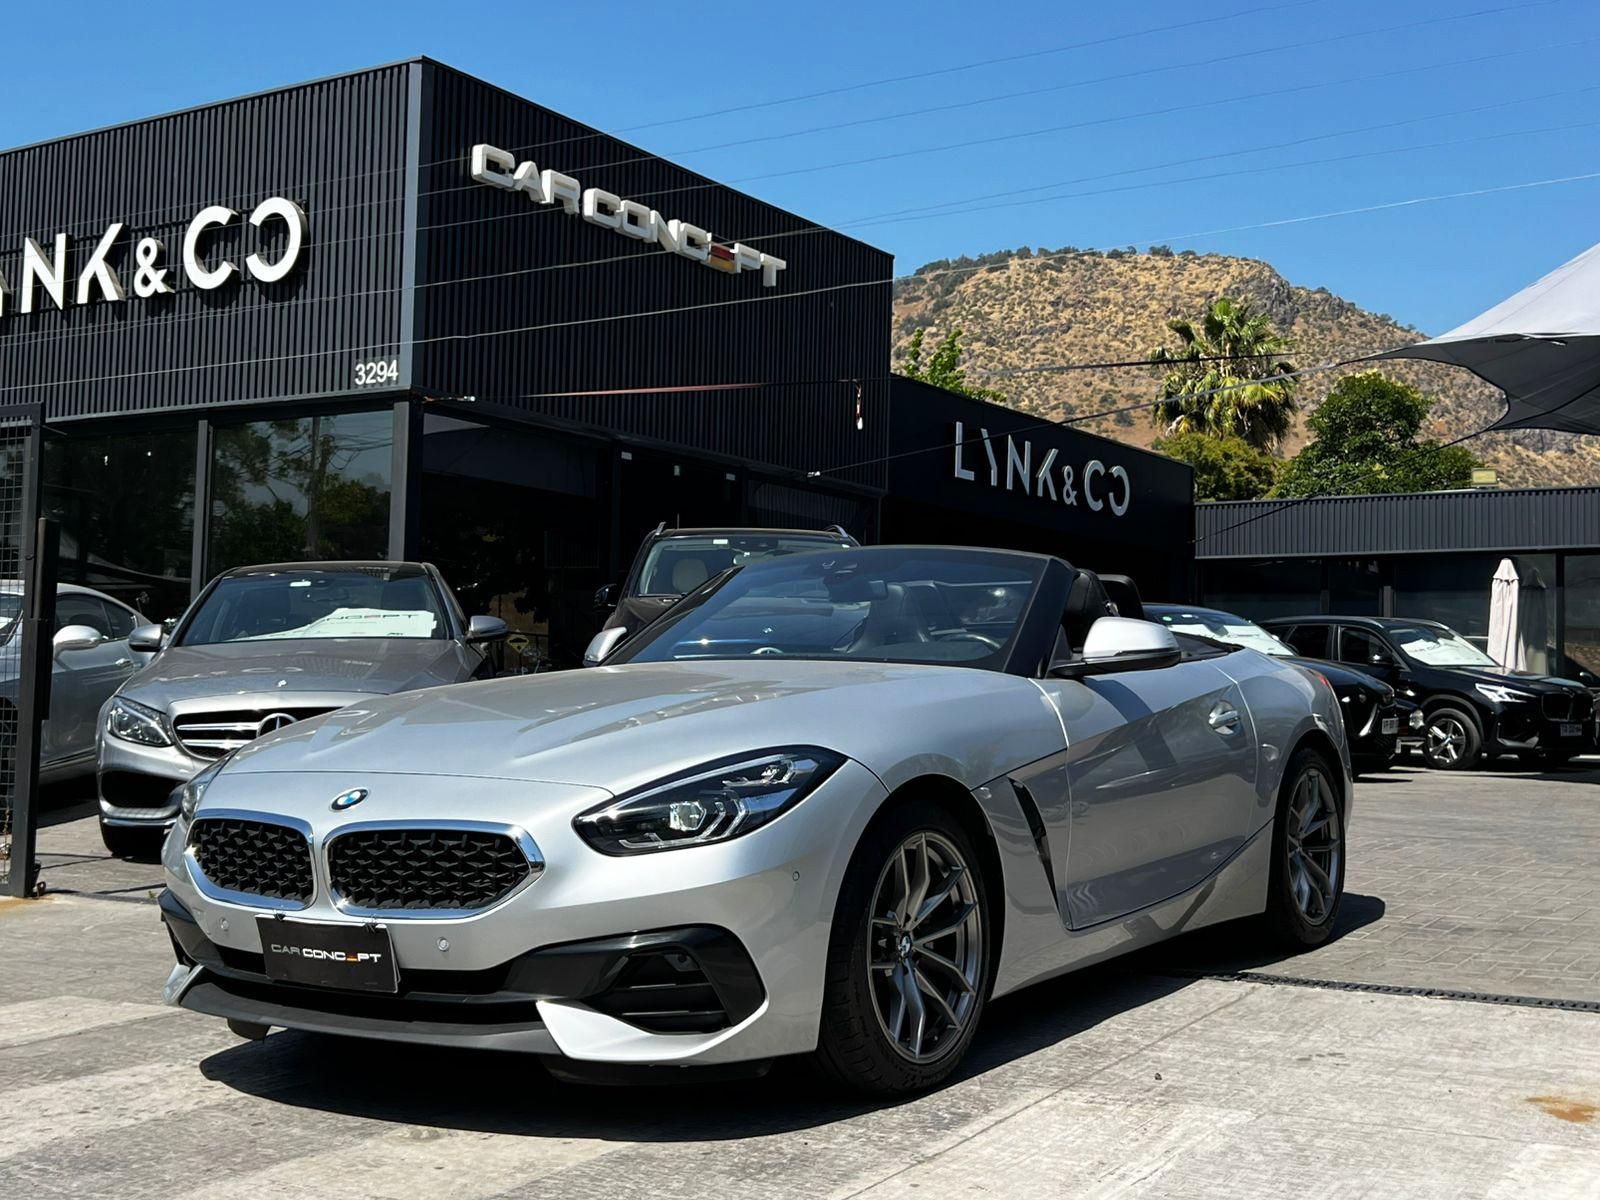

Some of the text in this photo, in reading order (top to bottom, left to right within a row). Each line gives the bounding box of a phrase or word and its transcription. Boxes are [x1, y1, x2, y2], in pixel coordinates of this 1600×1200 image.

[472, 144, 580, 215] CAR
[355, 360, 398, 385] 3294
[271, 944, 300, 955] CAR
